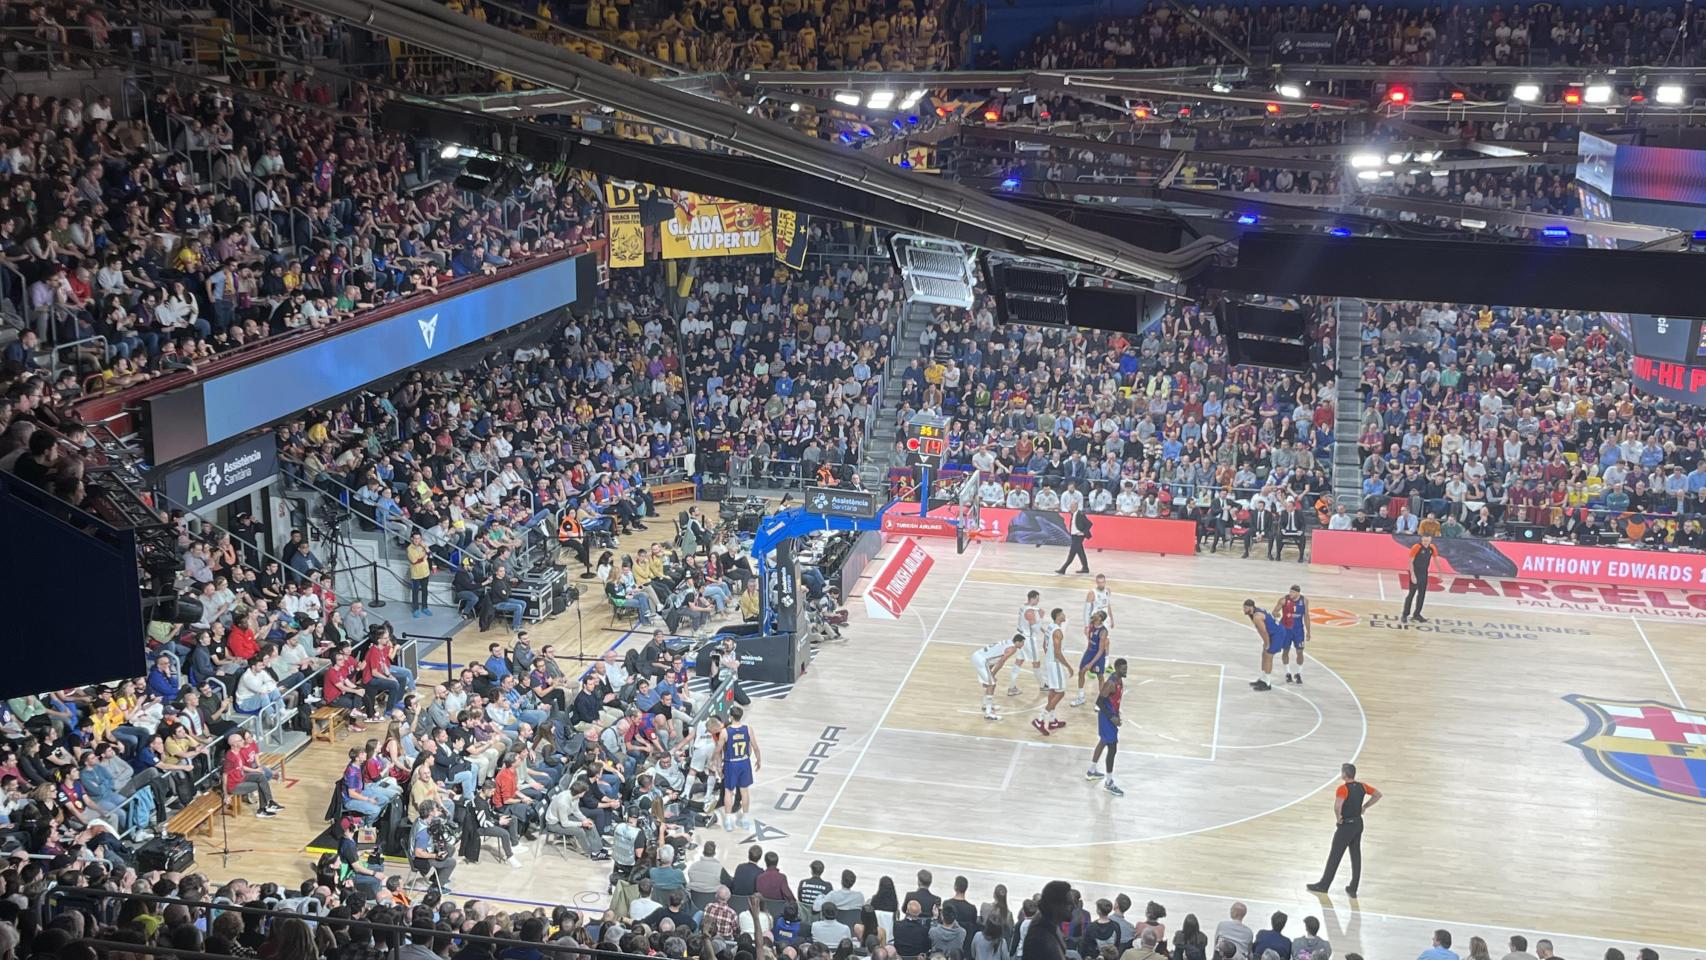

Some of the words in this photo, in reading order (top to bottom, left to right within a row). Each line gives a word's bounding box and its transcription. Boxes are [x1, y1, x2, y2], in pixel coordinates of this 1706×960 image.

[688, 233, 713, 250] VIU
[715, 232, 740, 249] PER
[743, 231, 760, 247] TU
[925, 439, 941, 454] 14
[223, 450, 262, 474] Assistència
[187, 470, 203, 506] A
[885, 566, 913, 599] TURKISH
[902, 544, 928, 576] AIRLINES
[1522, 555, 1602, 576] ANTHONY
[1607, 561, 1694, 582] EDWARDS
[1516, 599, 1591, 611] PALAU
[1369, 620, 1538, 640] EuroLeague
[1482, 622, 1592, 636] AIRLINES
[732, 741, 747, 756] 17
[774, 725, 847, 811] CUPRA
